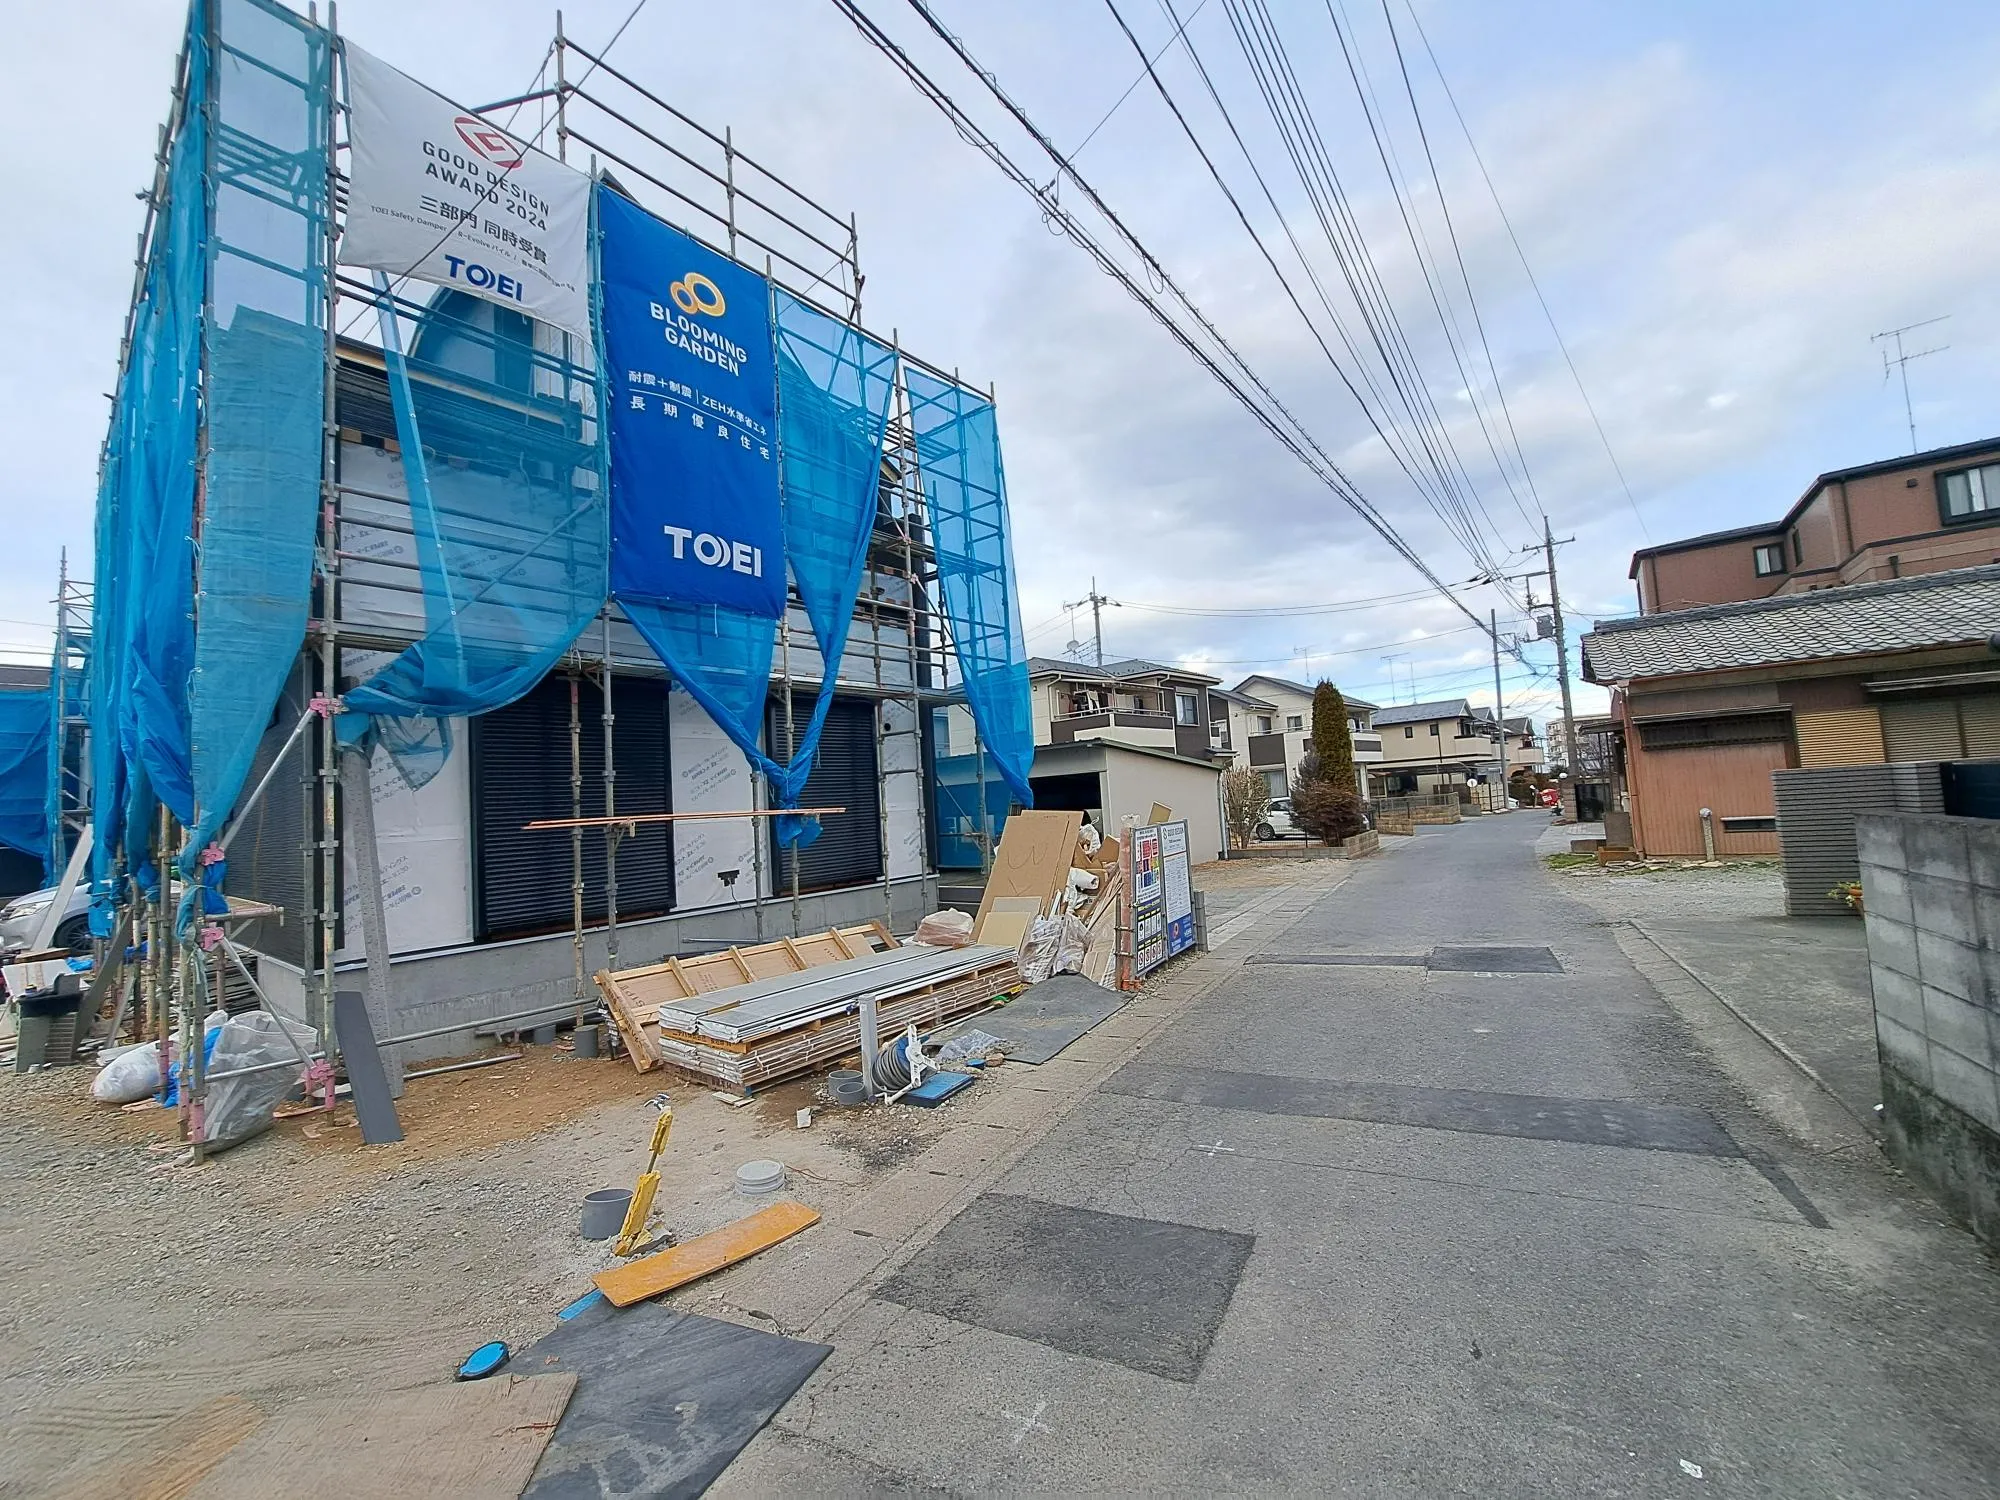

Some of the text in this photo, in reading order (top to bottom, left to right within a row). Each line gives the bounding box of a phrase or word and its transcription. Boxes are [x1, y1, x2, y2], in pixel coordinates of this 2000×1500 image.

[423, 141, 549, 217] GOOD DESIGN
[425, 163, 547, 232] AWARD 2024
[371, 205, 389, 215] TOEI
[390, 210, 415, 223] Safety
[416, 217, 447, 232] Damper
[419, 194, 548, 265] 三部門 同時受賞
[445, 254, 522, 302] TOEI
[649, 301, 748, 364] BLOOMING
[664, 326, 741, 377] GARDEN
[630, 395, 771, 460] 長期優良住宅
[664, 526, 762, 577] TOEI
